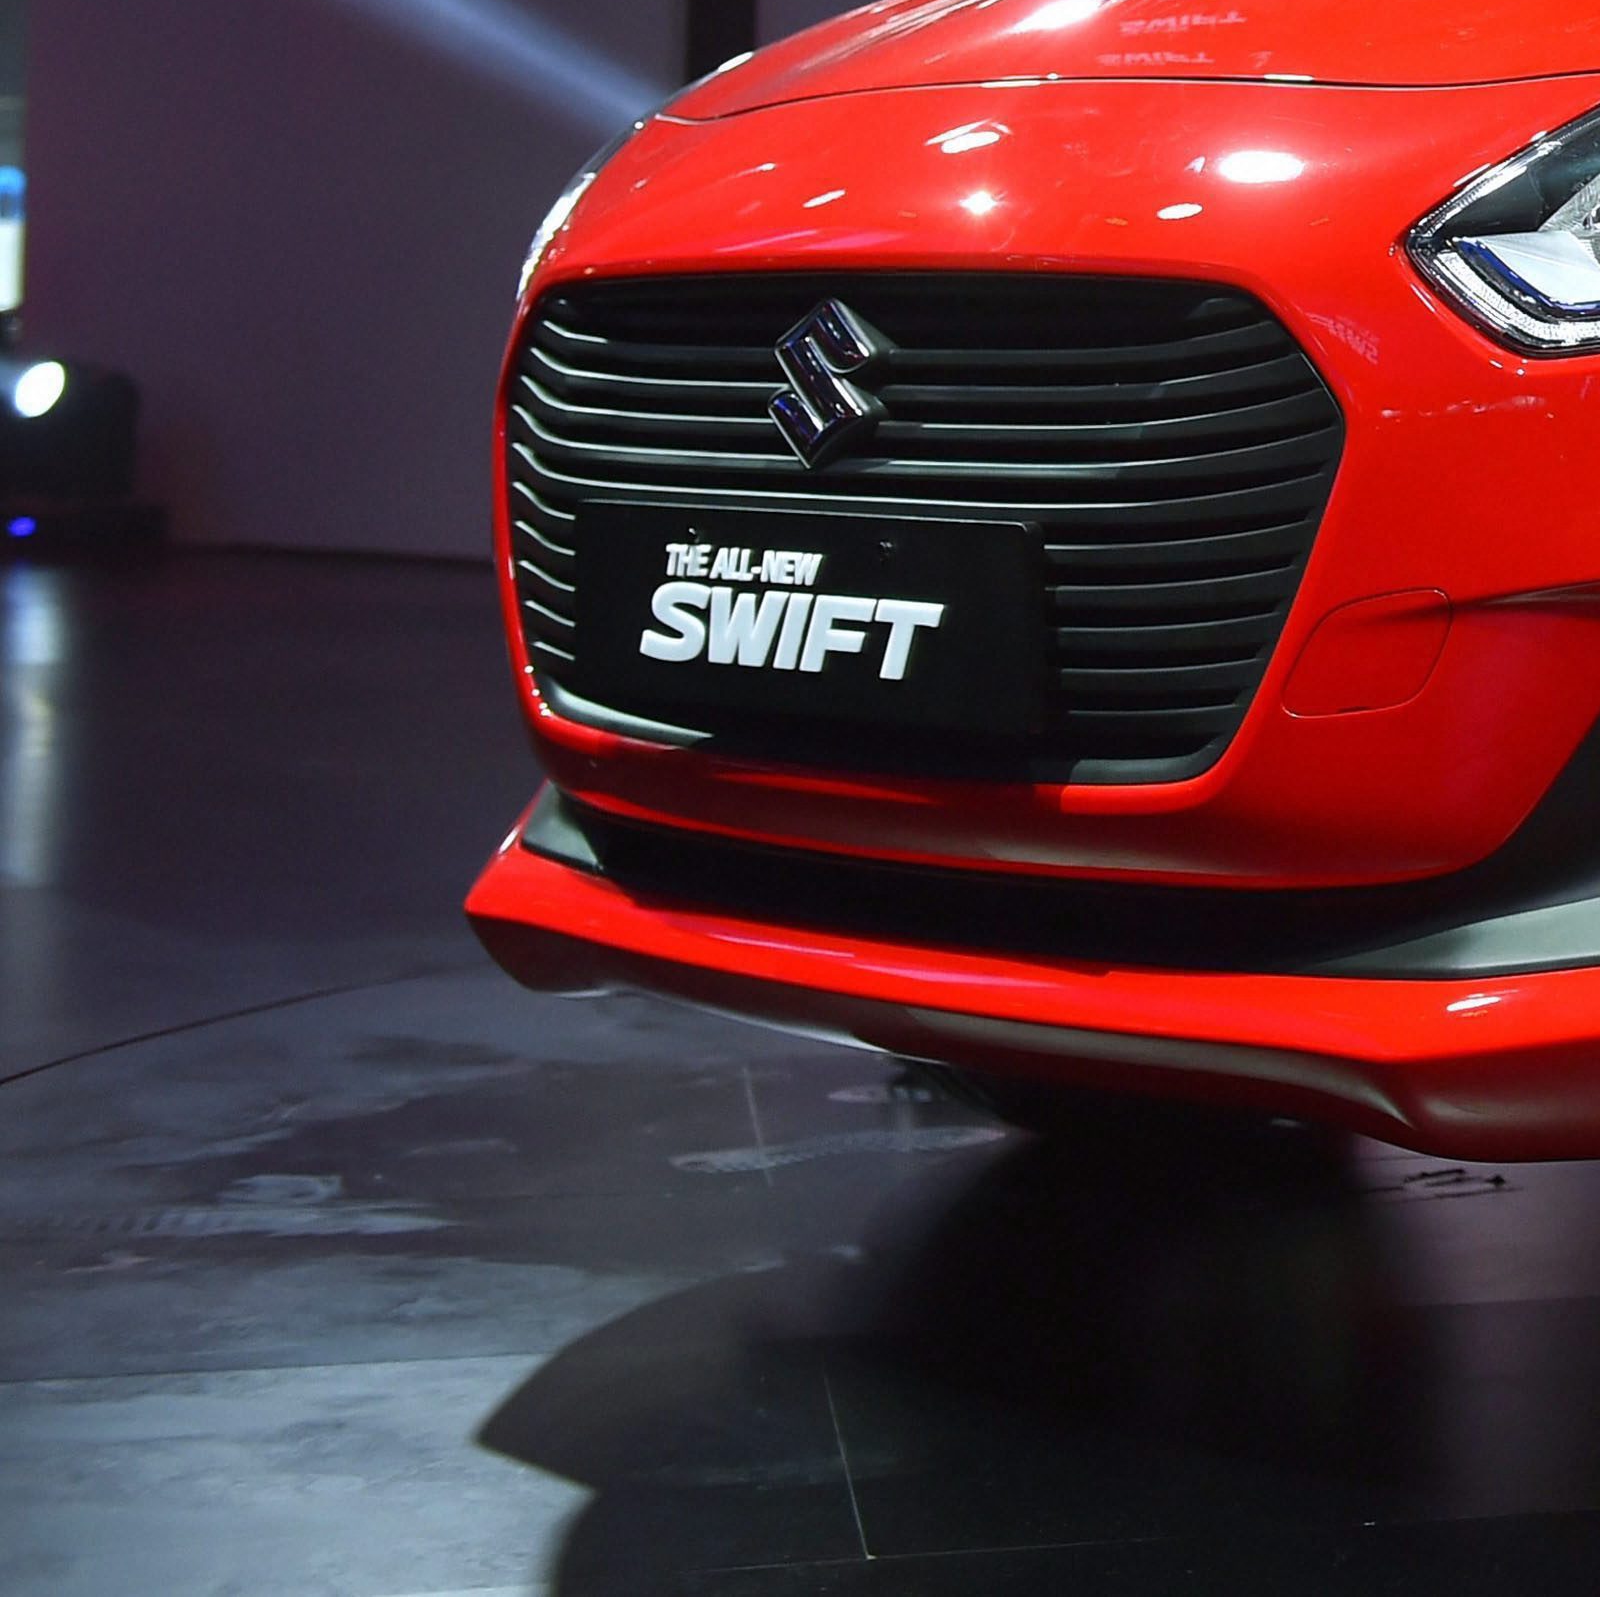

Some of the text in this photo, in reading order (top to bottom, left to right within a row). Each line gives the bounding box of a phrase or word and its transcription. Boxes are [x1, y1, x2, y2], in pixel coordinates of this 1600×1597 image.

[665, 543, 823, 586] THE ALL-NEW
[639, 580, 945, 681] SWIFT
